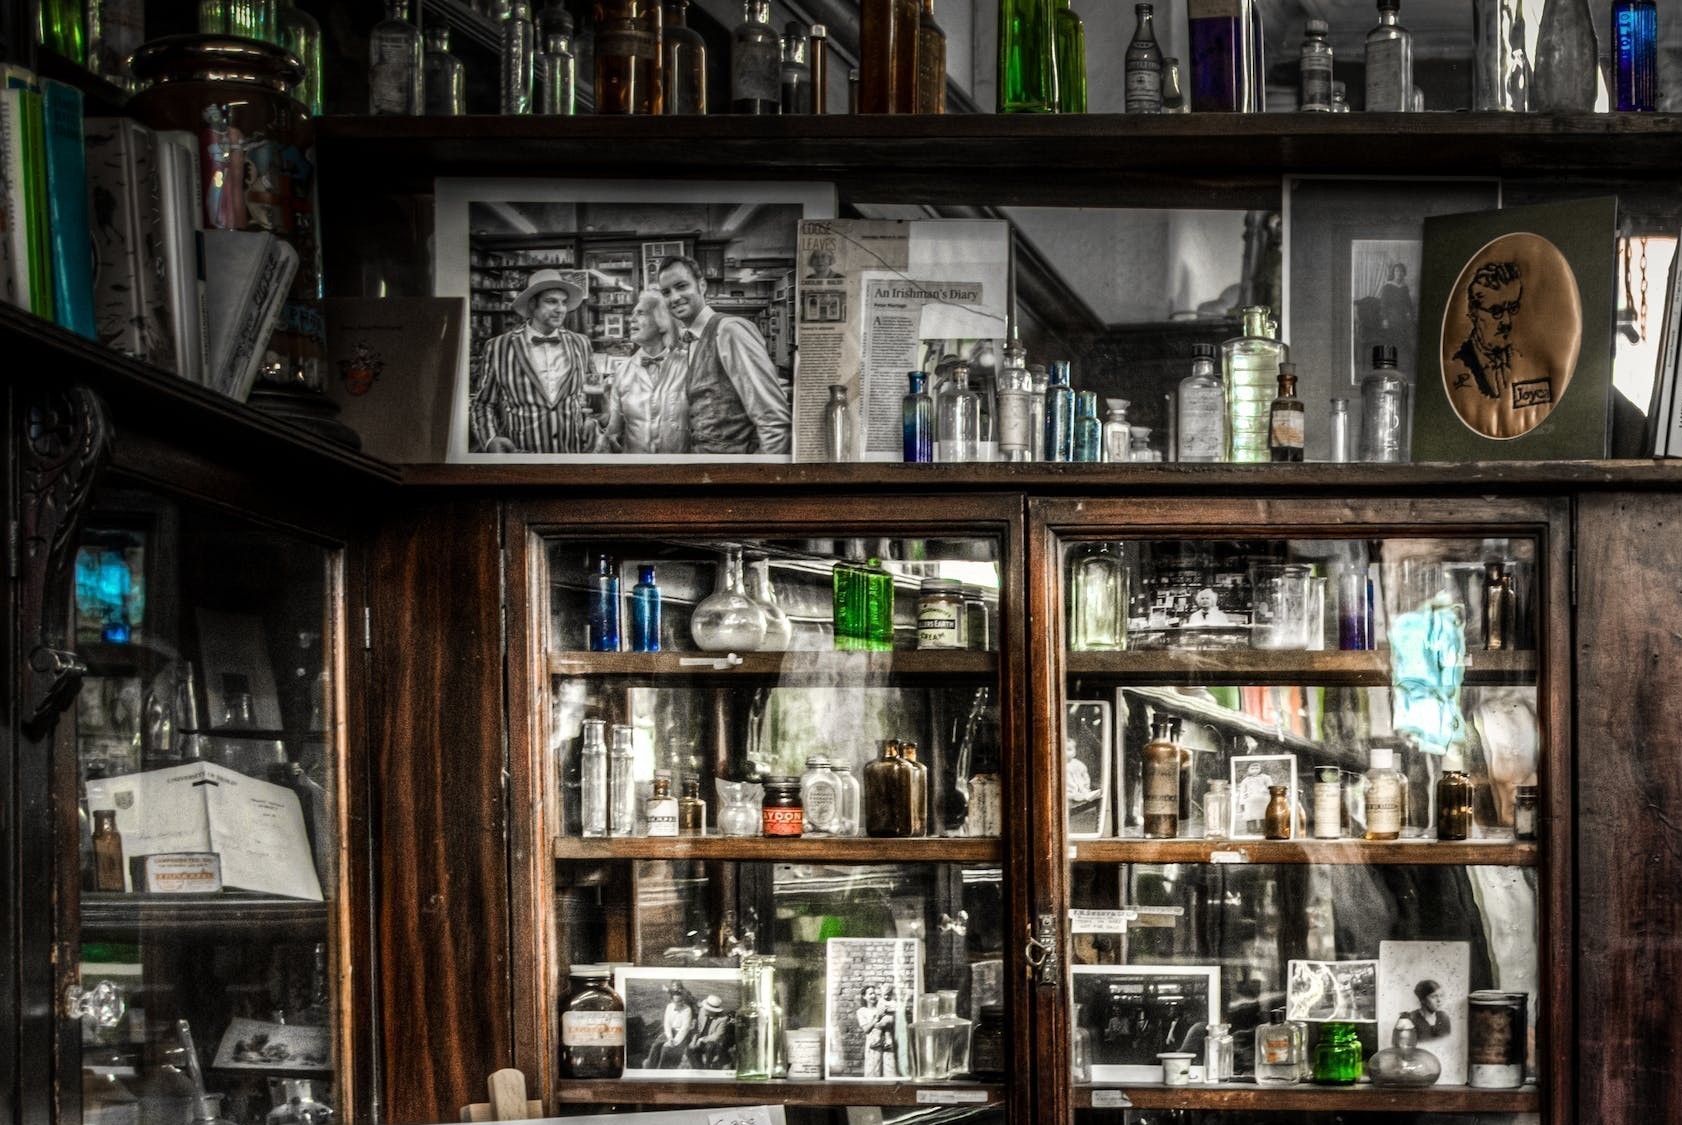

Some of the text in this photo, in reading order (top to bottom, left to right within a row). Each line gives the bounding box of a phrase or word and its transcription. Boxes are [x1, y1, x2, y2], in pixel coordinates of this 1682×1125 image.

[802, 237, 838, 250] LEAVES
[873, 287, 979, 301] An Irishman's Diary
